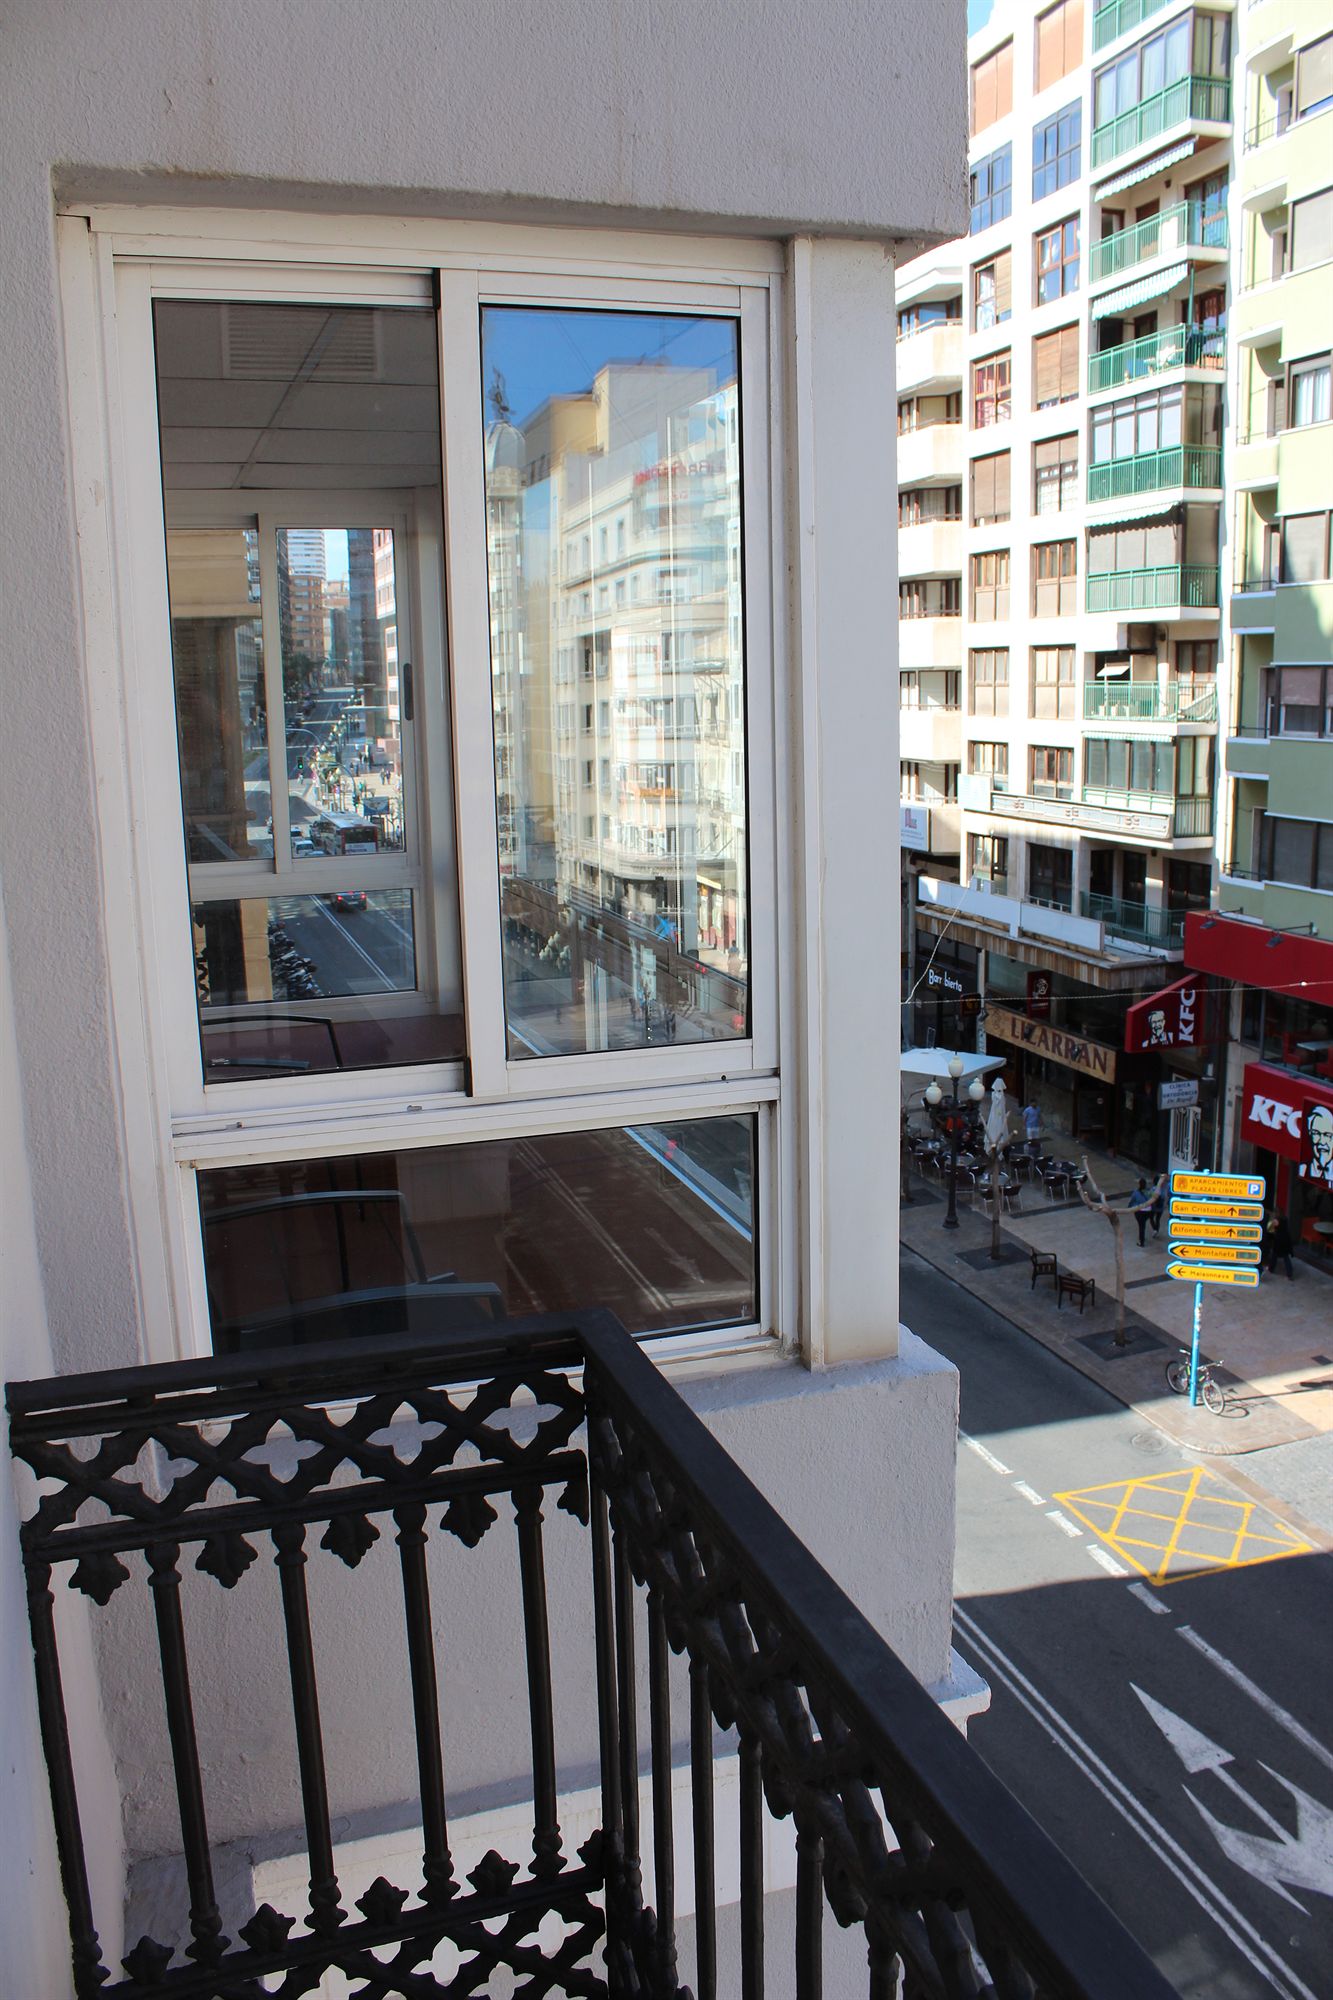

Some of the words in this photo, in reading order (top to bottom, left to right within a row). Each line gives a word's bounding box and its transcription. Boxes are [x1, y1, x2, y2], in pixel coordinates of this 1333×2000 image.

[1179, 988, 1196, 1044] KFC
[1248, 1094, 1303, 1139] KFC
[1190, 1178, 1247, 1188] APARCAMIENTOS
[1250, 1184, 1259, 1194] P
[1173, 1226, 1201, 1234] Alfonso
[1204, 1228, 1227, 1236] Sabio
